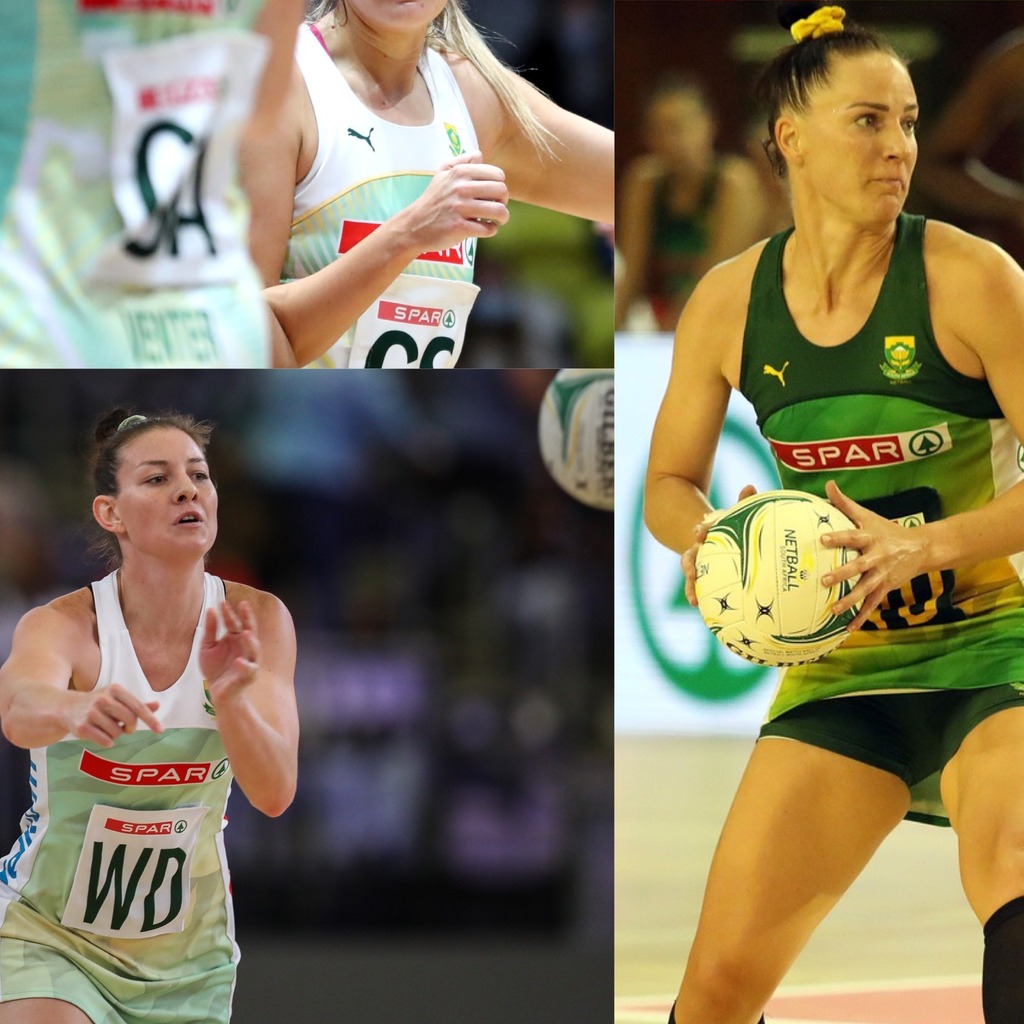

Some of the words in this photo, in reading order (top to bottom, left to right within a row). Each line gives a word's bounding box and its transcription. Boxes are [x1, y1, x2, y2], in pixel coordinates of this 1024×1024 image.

[394, 306, 442, 325] SPAR
[792, 440, 901, 467] SPAR
[784, 529, 800, 592] NETBALL
[110, 767, 207, 782] SPAR
[121, 822, 171, 833] SPAR
[83, 841, 187, 933] WD
